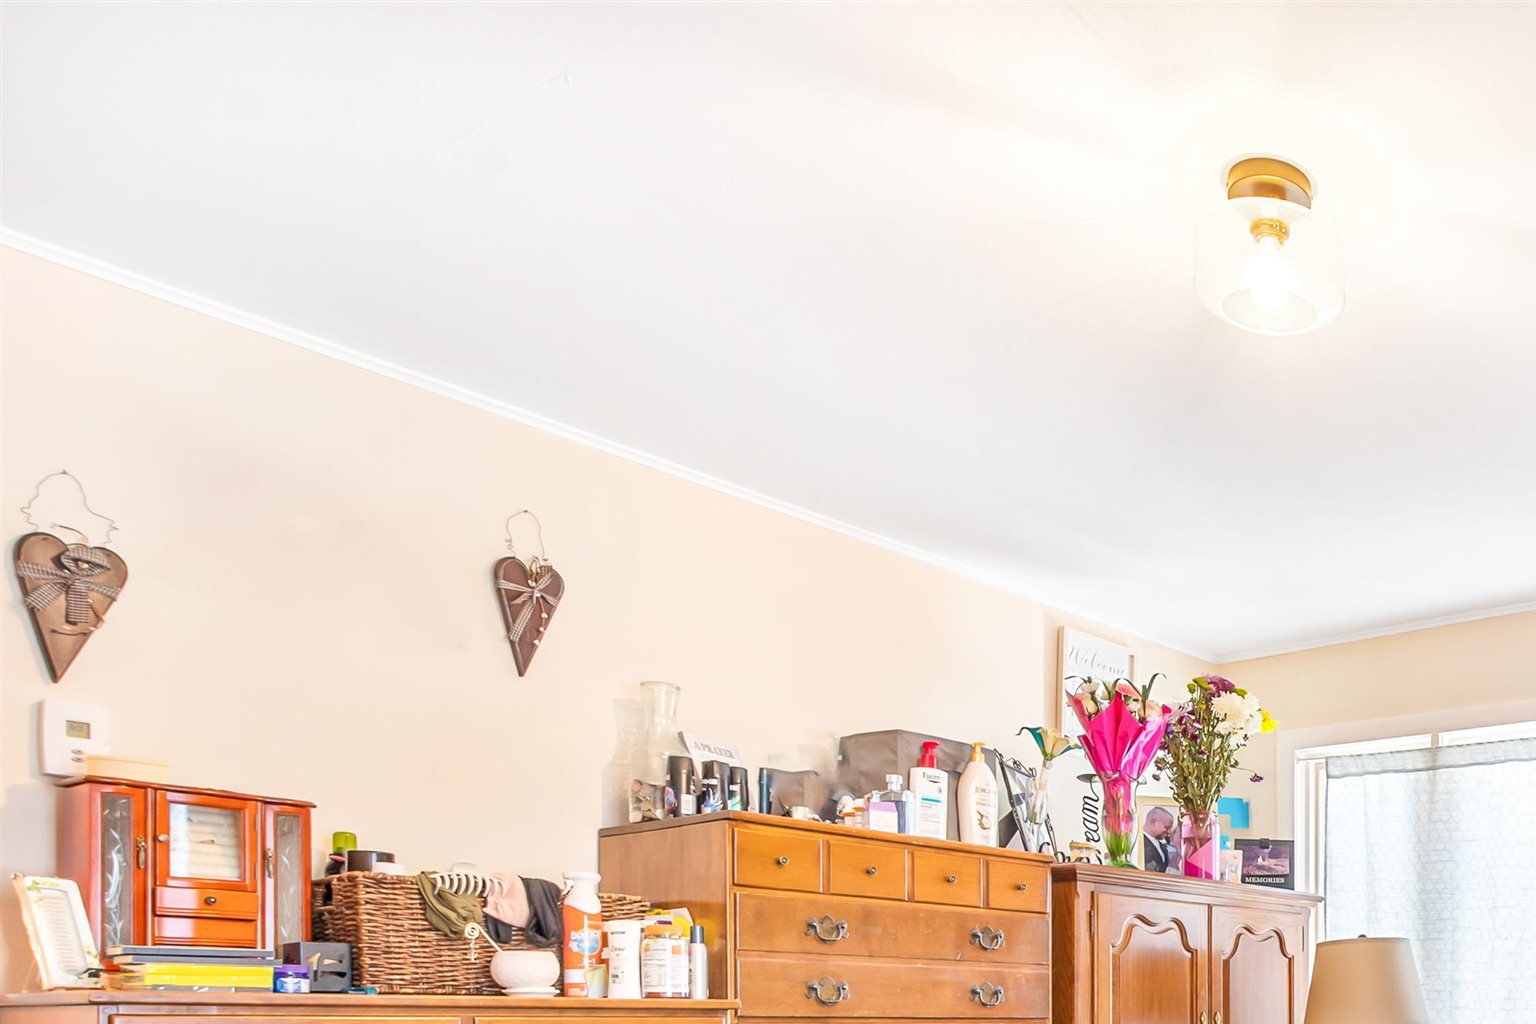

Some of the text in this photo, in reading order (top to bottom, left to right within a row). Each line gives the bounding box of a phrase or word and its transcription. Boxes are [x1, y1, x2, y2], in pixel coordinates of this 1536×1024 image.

[1068, 645, 1126, 676] Welcome
[701, 742, 736, 759] PRAYER
[1244, 876, 1286, 884] MEMORIES
